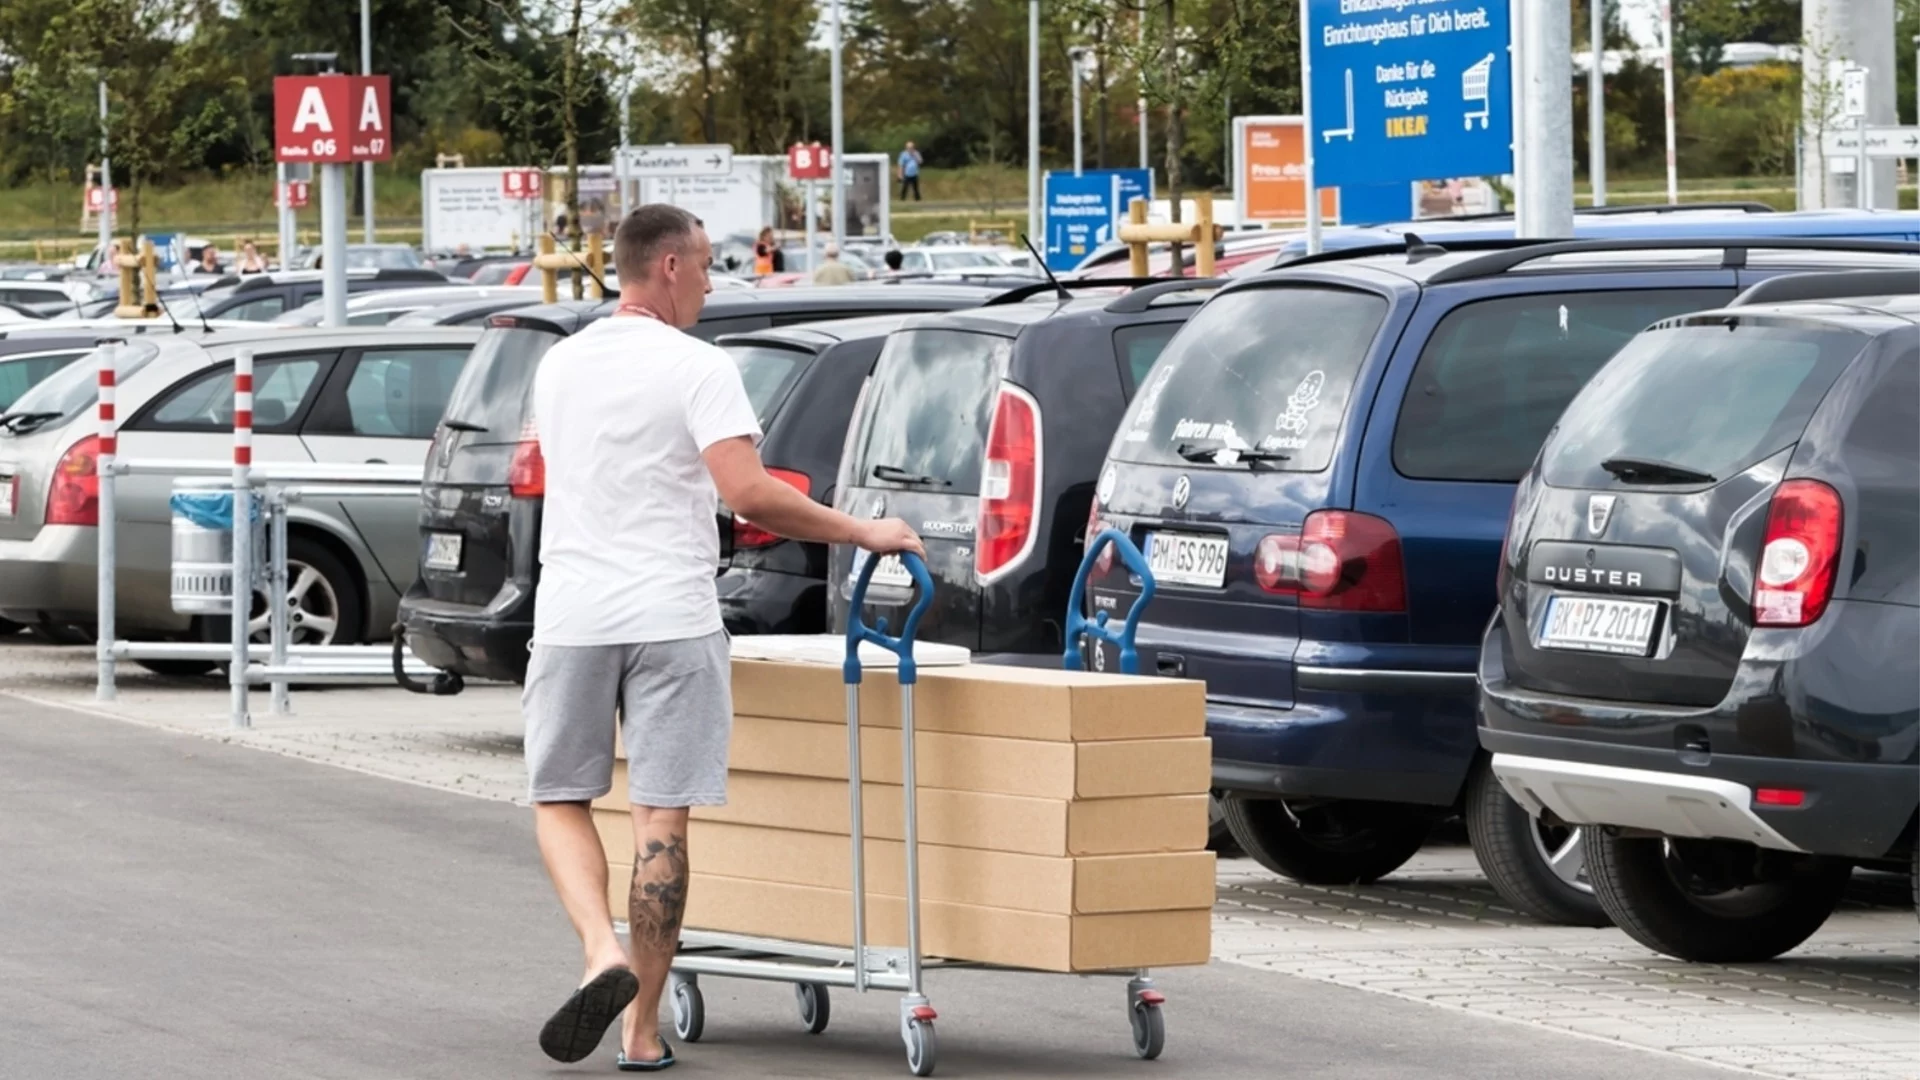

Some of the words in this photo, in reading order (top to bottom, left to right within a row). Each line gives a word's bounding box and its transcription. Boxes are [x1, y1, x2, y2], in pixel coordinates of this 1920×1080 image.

[1323, 18, 1408, 47] Einrichtungshaus
[1410, 14, 1427, 35] für
[1428, 10, 1452, 34] Dich
[1454, 7, 1490, 30] bereit.
[1376, 63, 1404, 83] Danke
[1405, 60, 1420, 80] für
[1420, 60, 1436, 79] die
[292, 86, 333, 132] A
[359, 86, 382, 131] A
[1384, 87, 1428, 110] Rückgabe
[1386, 115, 1427, 138] IKEA
[312, 139, 336, 155] 06
[370, 139, 384, 155] 07
[1837, 139, 1887, 148] Ausahrt
[634, 158, 689, 168] Ausfahrt
[796, 149, 812, 169] B
[922, 521, 974, 533] ROOMSTER
[1151, 538, 1170, 569] PM
[1176, 541, 1197, 572] GS
[1197, 543, 1225, 574] 996
[1545, 566, 1642, 587] DUSTER
[1580, 602, 1606, 638] PZ
[1603, 605, 1653, 641] 2011
